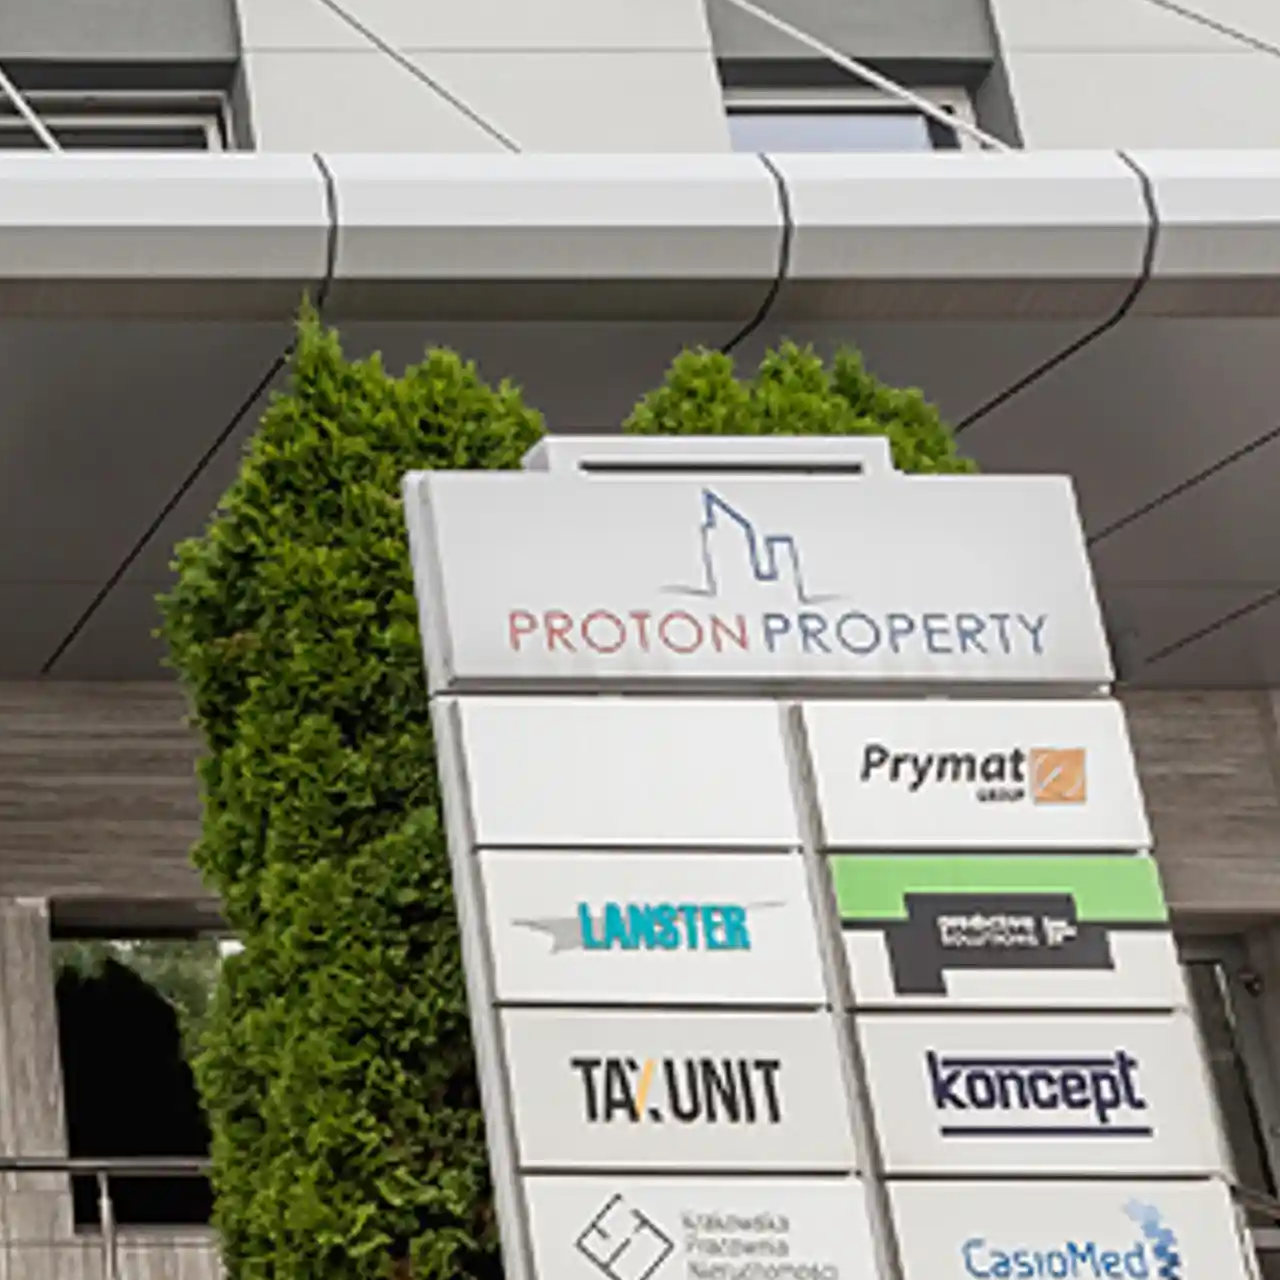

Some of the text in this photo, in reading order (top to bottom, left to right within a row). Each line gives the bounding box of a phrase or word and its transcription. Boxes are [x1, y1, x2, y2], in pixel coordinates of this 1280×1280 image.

[508, 609, 1048, 655] PROTON PROPERTY
[860, 743, 1026, 792] Prymat
[578, 902, 751, 950] LANSTER
[925, 1050, 1147, 1124] koncept
[962, 1238, 1149, 1280] CasioMed
